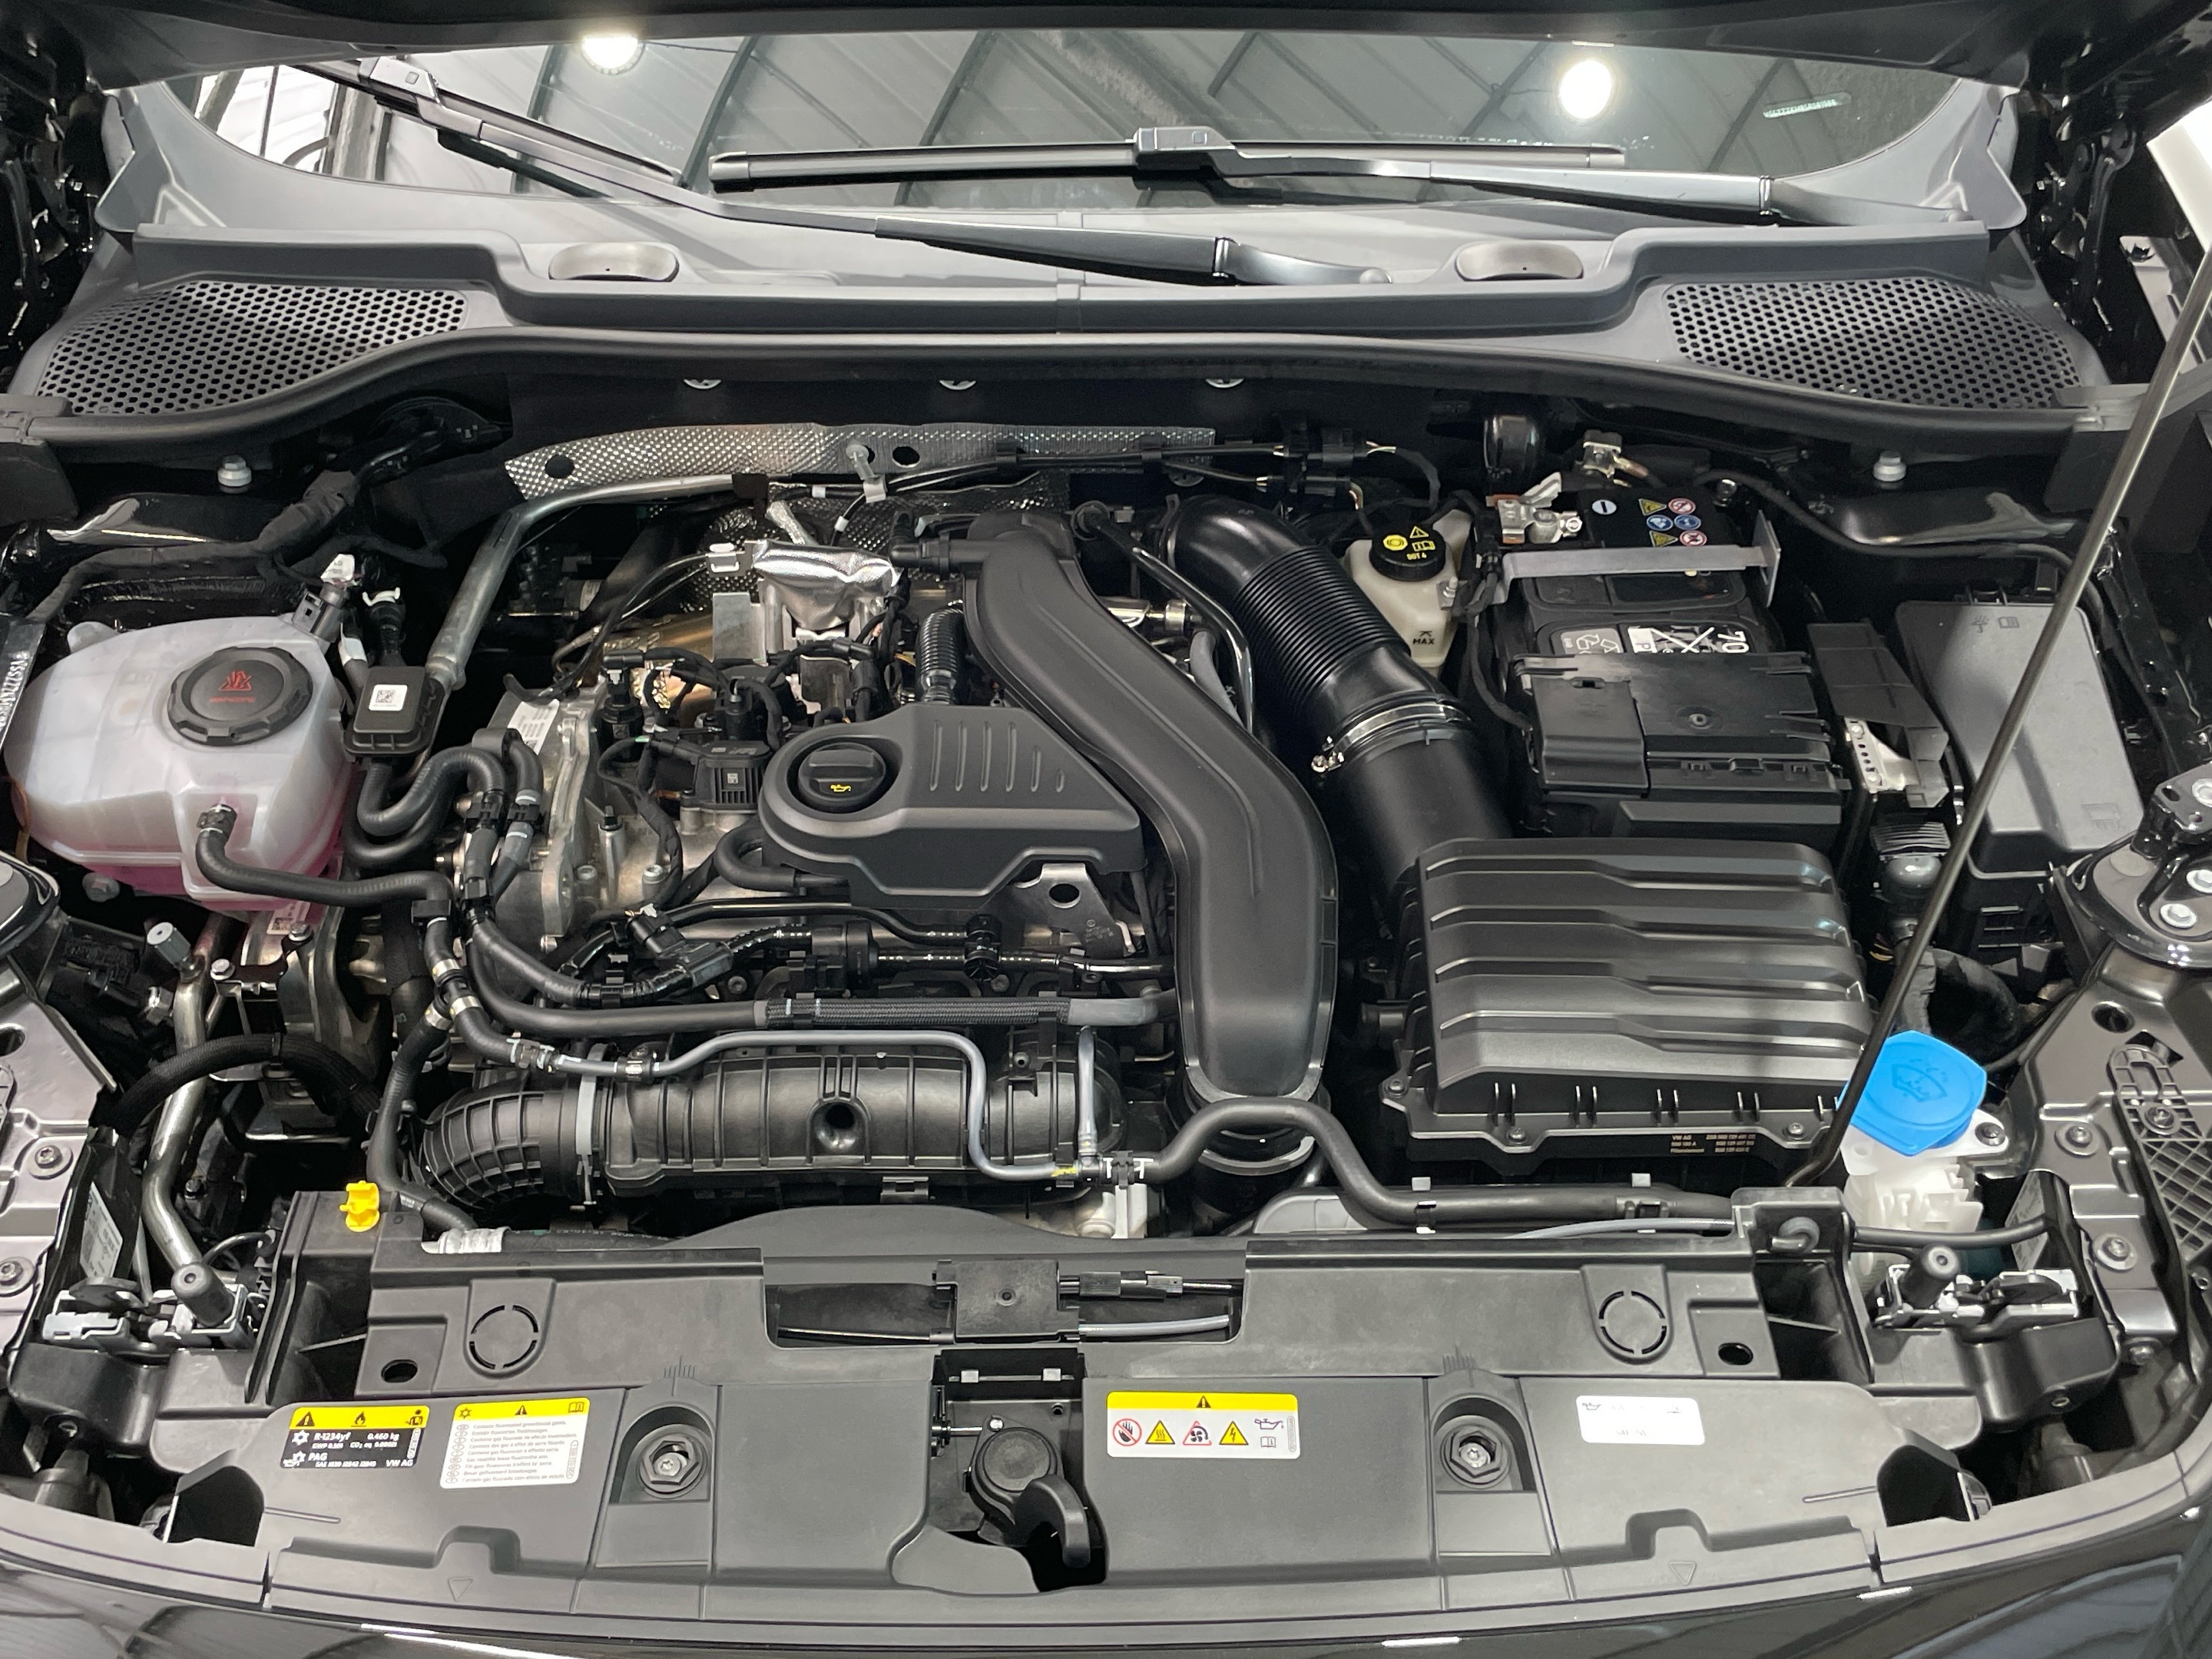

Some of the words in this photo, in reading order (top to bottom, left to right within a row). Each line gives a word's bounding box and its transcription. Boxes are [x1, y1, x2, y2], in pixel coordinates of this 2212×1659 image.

[1717, 631, 1750, 653] 70
[313, 1432, 351, 1442] R-1234yf
[308, 1452, 328, 1461] PAG
